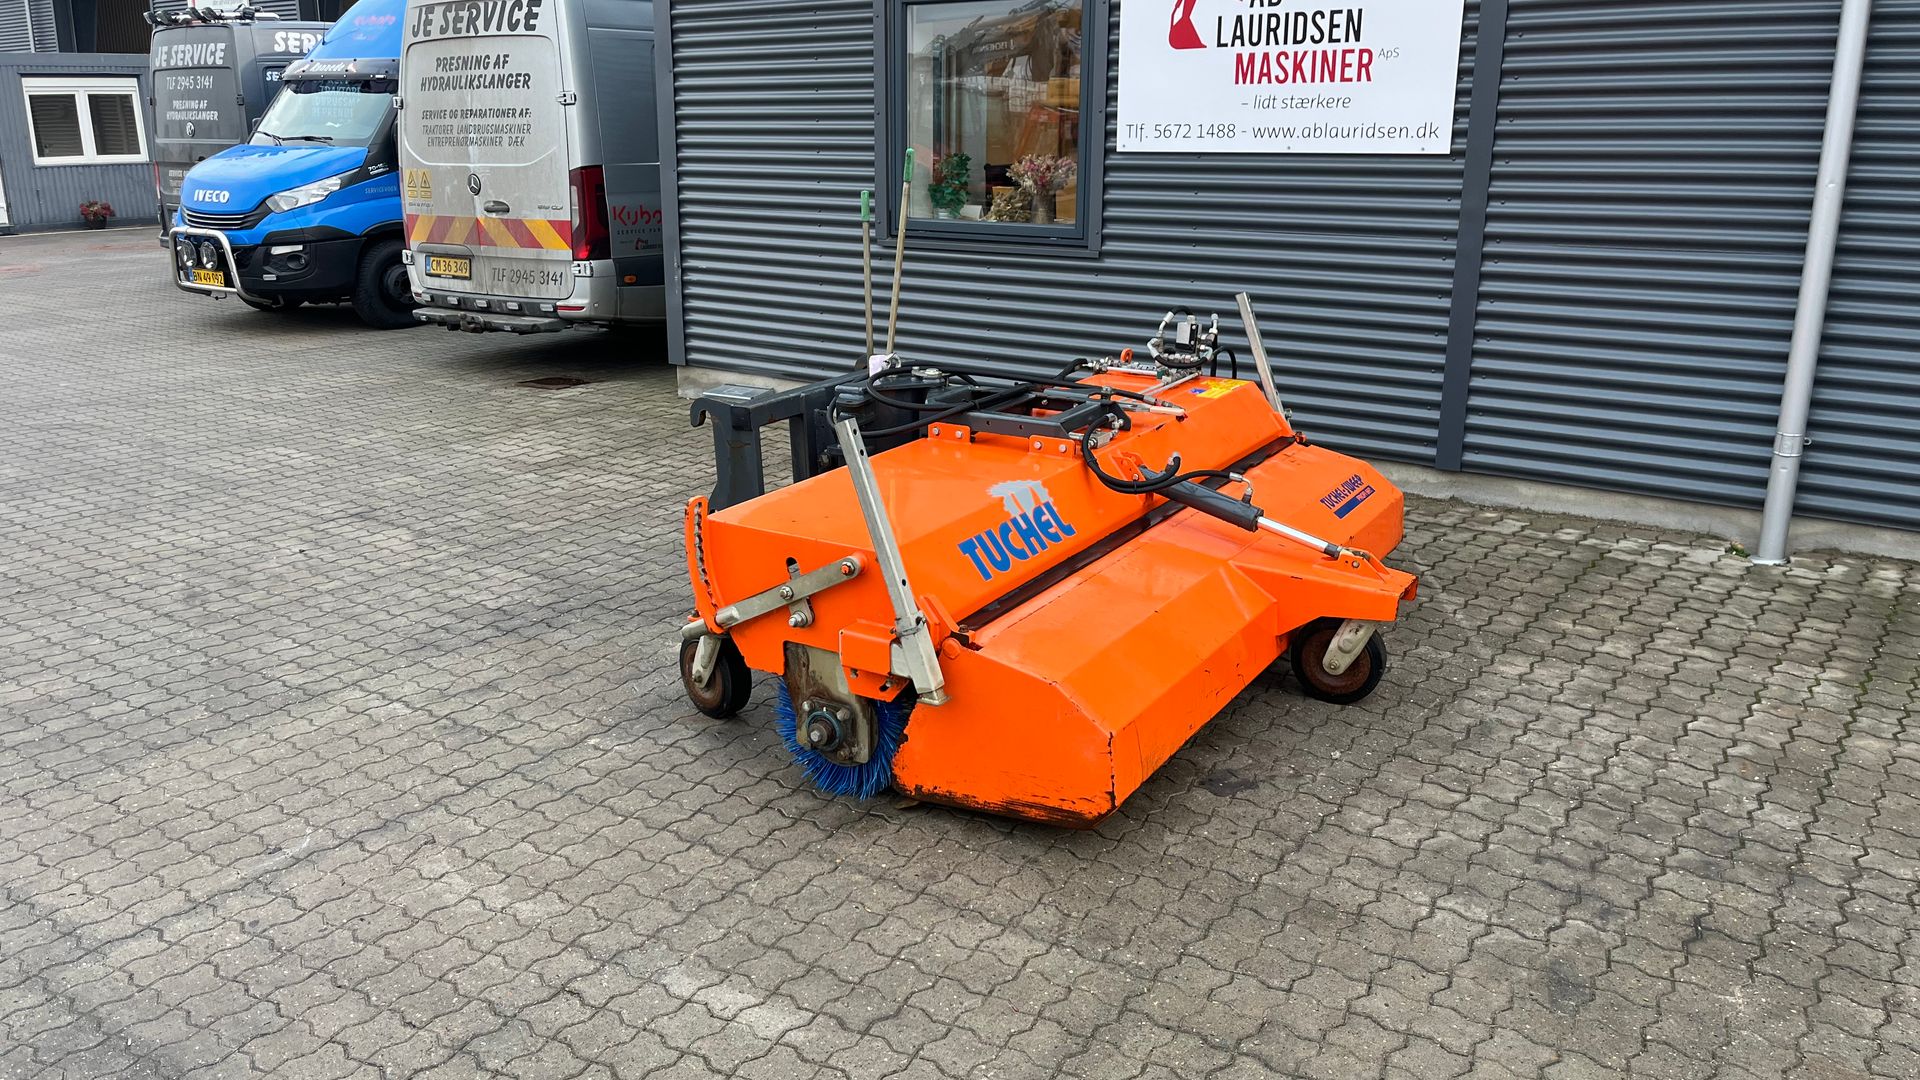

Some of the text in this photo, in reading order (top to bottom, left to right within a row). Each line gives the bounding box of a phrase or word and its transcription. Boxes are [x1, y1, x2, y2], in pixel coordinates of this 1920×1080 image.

[412, 0, 542, 38] JE SERVICE
[1217, 8, 1363, 48] LAURIDSEN
[155, 43, 226, 67] JE SERVICE
[436, 54, 510, 72] PRESNING AF
[1234, 48, 1400, 85] MASKINER ApS
[166, 76, 213, 90] TLF 2945 3141
[420, 73, 532, 92] HYDRAULIKSLANGER
[172, 100, 208, 110] PRESNING AF
[1253, 95, 1278, 110] lidt
[1280, 94, 1352, 110] stærkere
[422, 108, 532, 120] SERVICE OG REPARATIONER AF:
[422, 124, 532, 136] TRAKTORER LANDBRUGSMASKINER
[1126, 123, 1149, 142] Tlf.
[1154, 124, 1192, 138] 5672
[1196, 124, 1236, 138] 1488
[1252, 122, 1440, 140] www.ablauridsen.dk
[428, 136, 525, 148] ENTREPRENØRMASKINER DÆK
[194, 189, 230, 203] IVECO
[431, 259, 468, 274] CM 36 349
[492, 268, 564, 286] TLF 2945 3141
